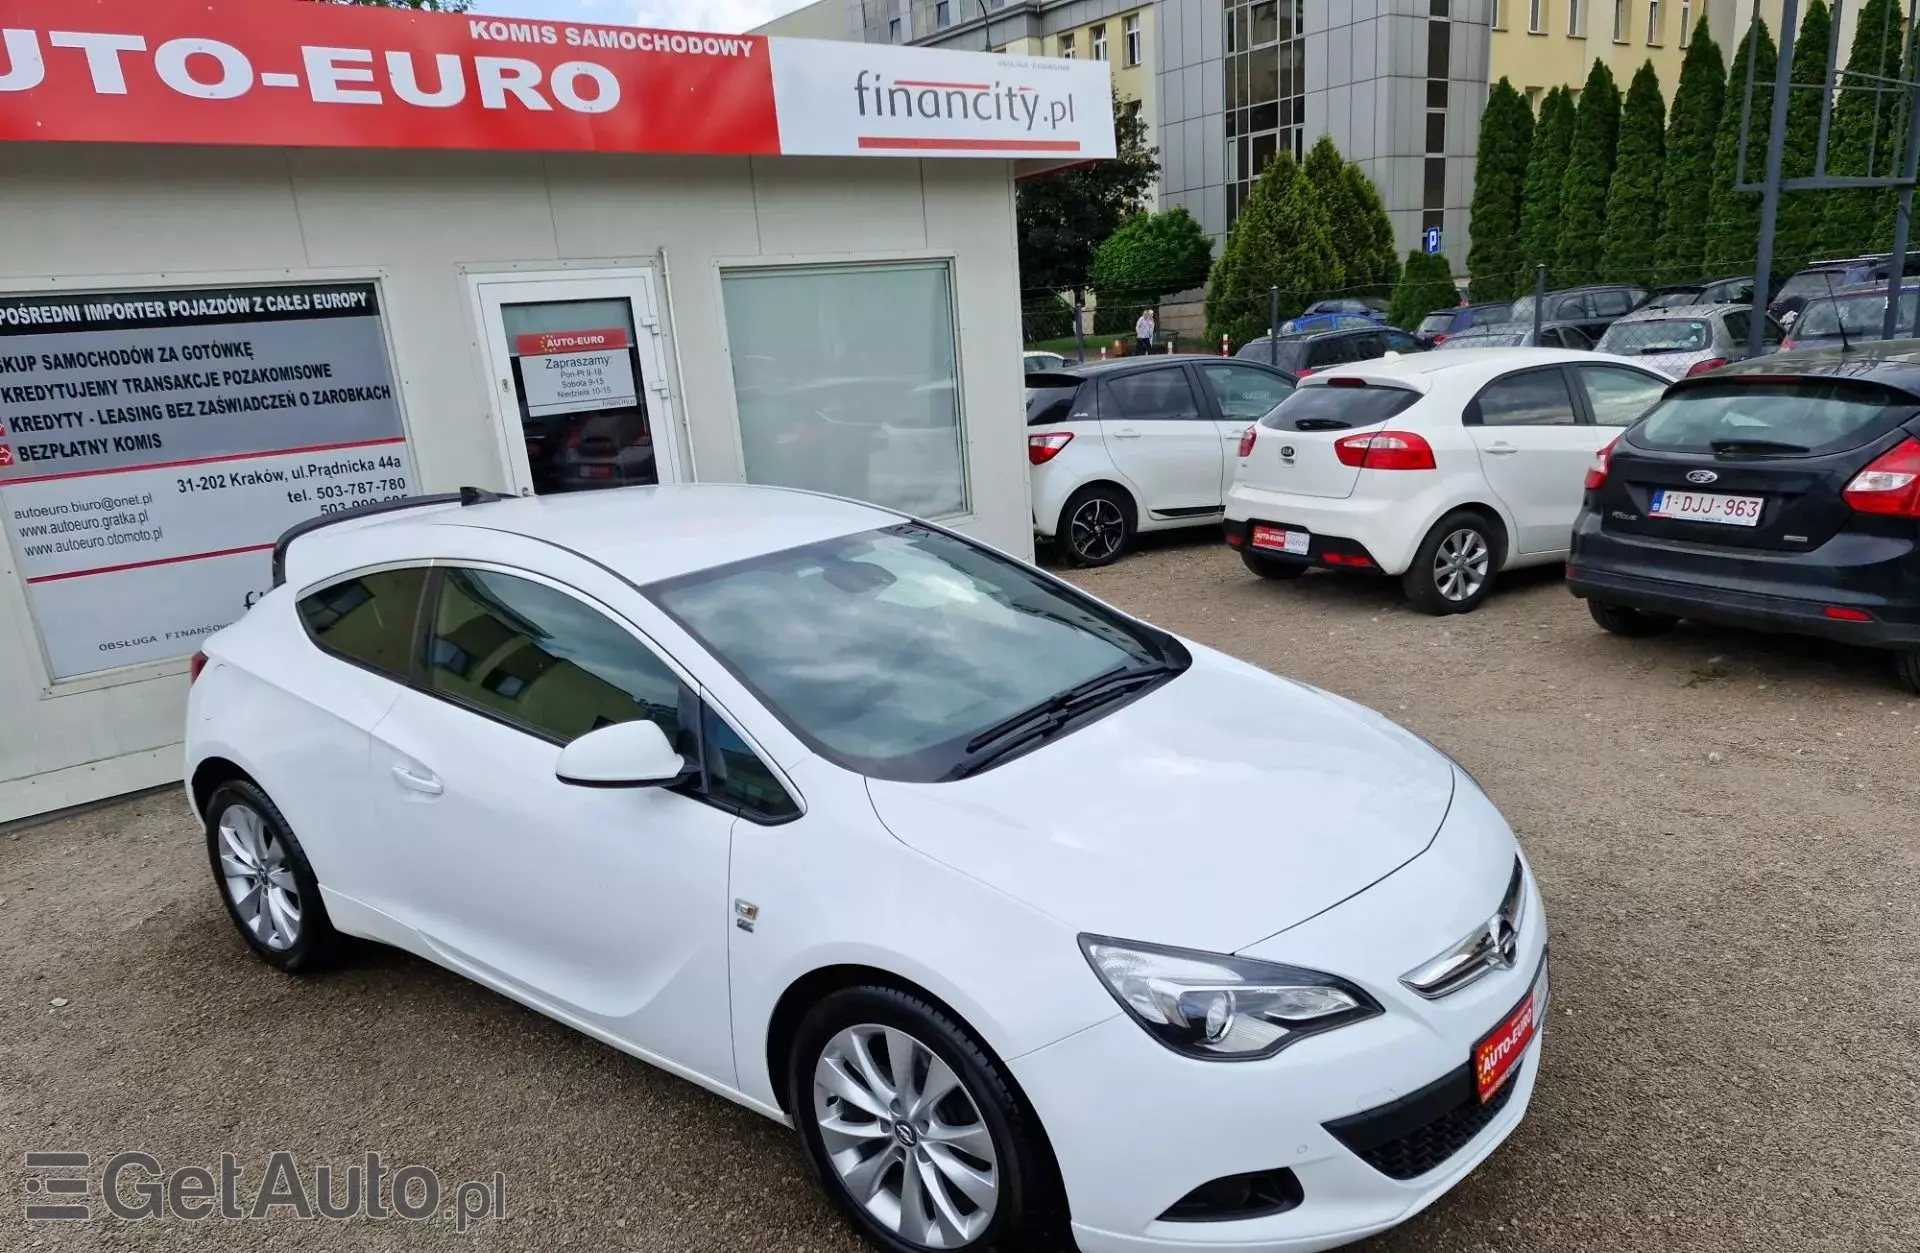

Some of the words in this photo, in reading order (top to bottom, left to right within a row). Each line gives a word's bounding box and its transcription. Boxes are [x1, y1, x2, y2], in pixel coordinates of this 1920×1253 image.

[469, 20, 558, 45] KOMIS
[566, 27, 753, 58] SAMOCHODOWY
[854, 70, 1075, 131] financity.pl
[1429, 230, 1437, 252] P
[84, 301, 167, 321] IMPORTER
[169, 294, 250, 317] POJAZDÓW
[253, 297, 264, 313] Z
[266, 295, 310, 312] CAŁEJ
[313, 292, 367, 309] EUROPY
[42, 345, 154, 371] SAMOCHODÓW
[158, 347, 179, 363] ZA
[182, 340, 254, 361] GOTÓWKĘ
[547, 335, 605, 348] AUTO-EURO
[1, 379, 118, 403] KREDYTUJEMY
[122, 372, 220, 394] TRANSAKCJE
[223, 363, 332, 386] POZAKOMISOWE
[588, 378, 605, 386] 9-15
[592, 387, 612, 396] 10-15
[9, 411, 84, 432] KREDYTY
[97, 405, 163, 425] LEASING
[165, 401, 196, 419] BEZ
[200, 389, 297, 416] ZAŚWIADCZEŃ
[300, 391, 310, 406] O
[312, 385, 391, 405] ZAROBKACH
[17, 438, 109, 462] BEZPŁATNY
[113, 433, 163, 453] KOMIS
[177, 474, 227, 493] 31-202
[230, 468, 288, 487] Kraków,
[292, 458, 375, 480] ul.Prądnicka
[378, 455, 402, 469] 44a
[287, 489, 311, 503] tel.
[316, 477, 406, 500] 503-787-780
[14, 493, 153, 520] autoeuro.biuro@onet.pl
[19, 509, 149, 538] www.autoeuro.gratka.pl
[24, 526, 163, 557] www.autoeuro.otomoto.pl
[98, 635, 158, 652] OBSŁUGA
[1483, 1007, 1532, 1075] AUTO-EURO
